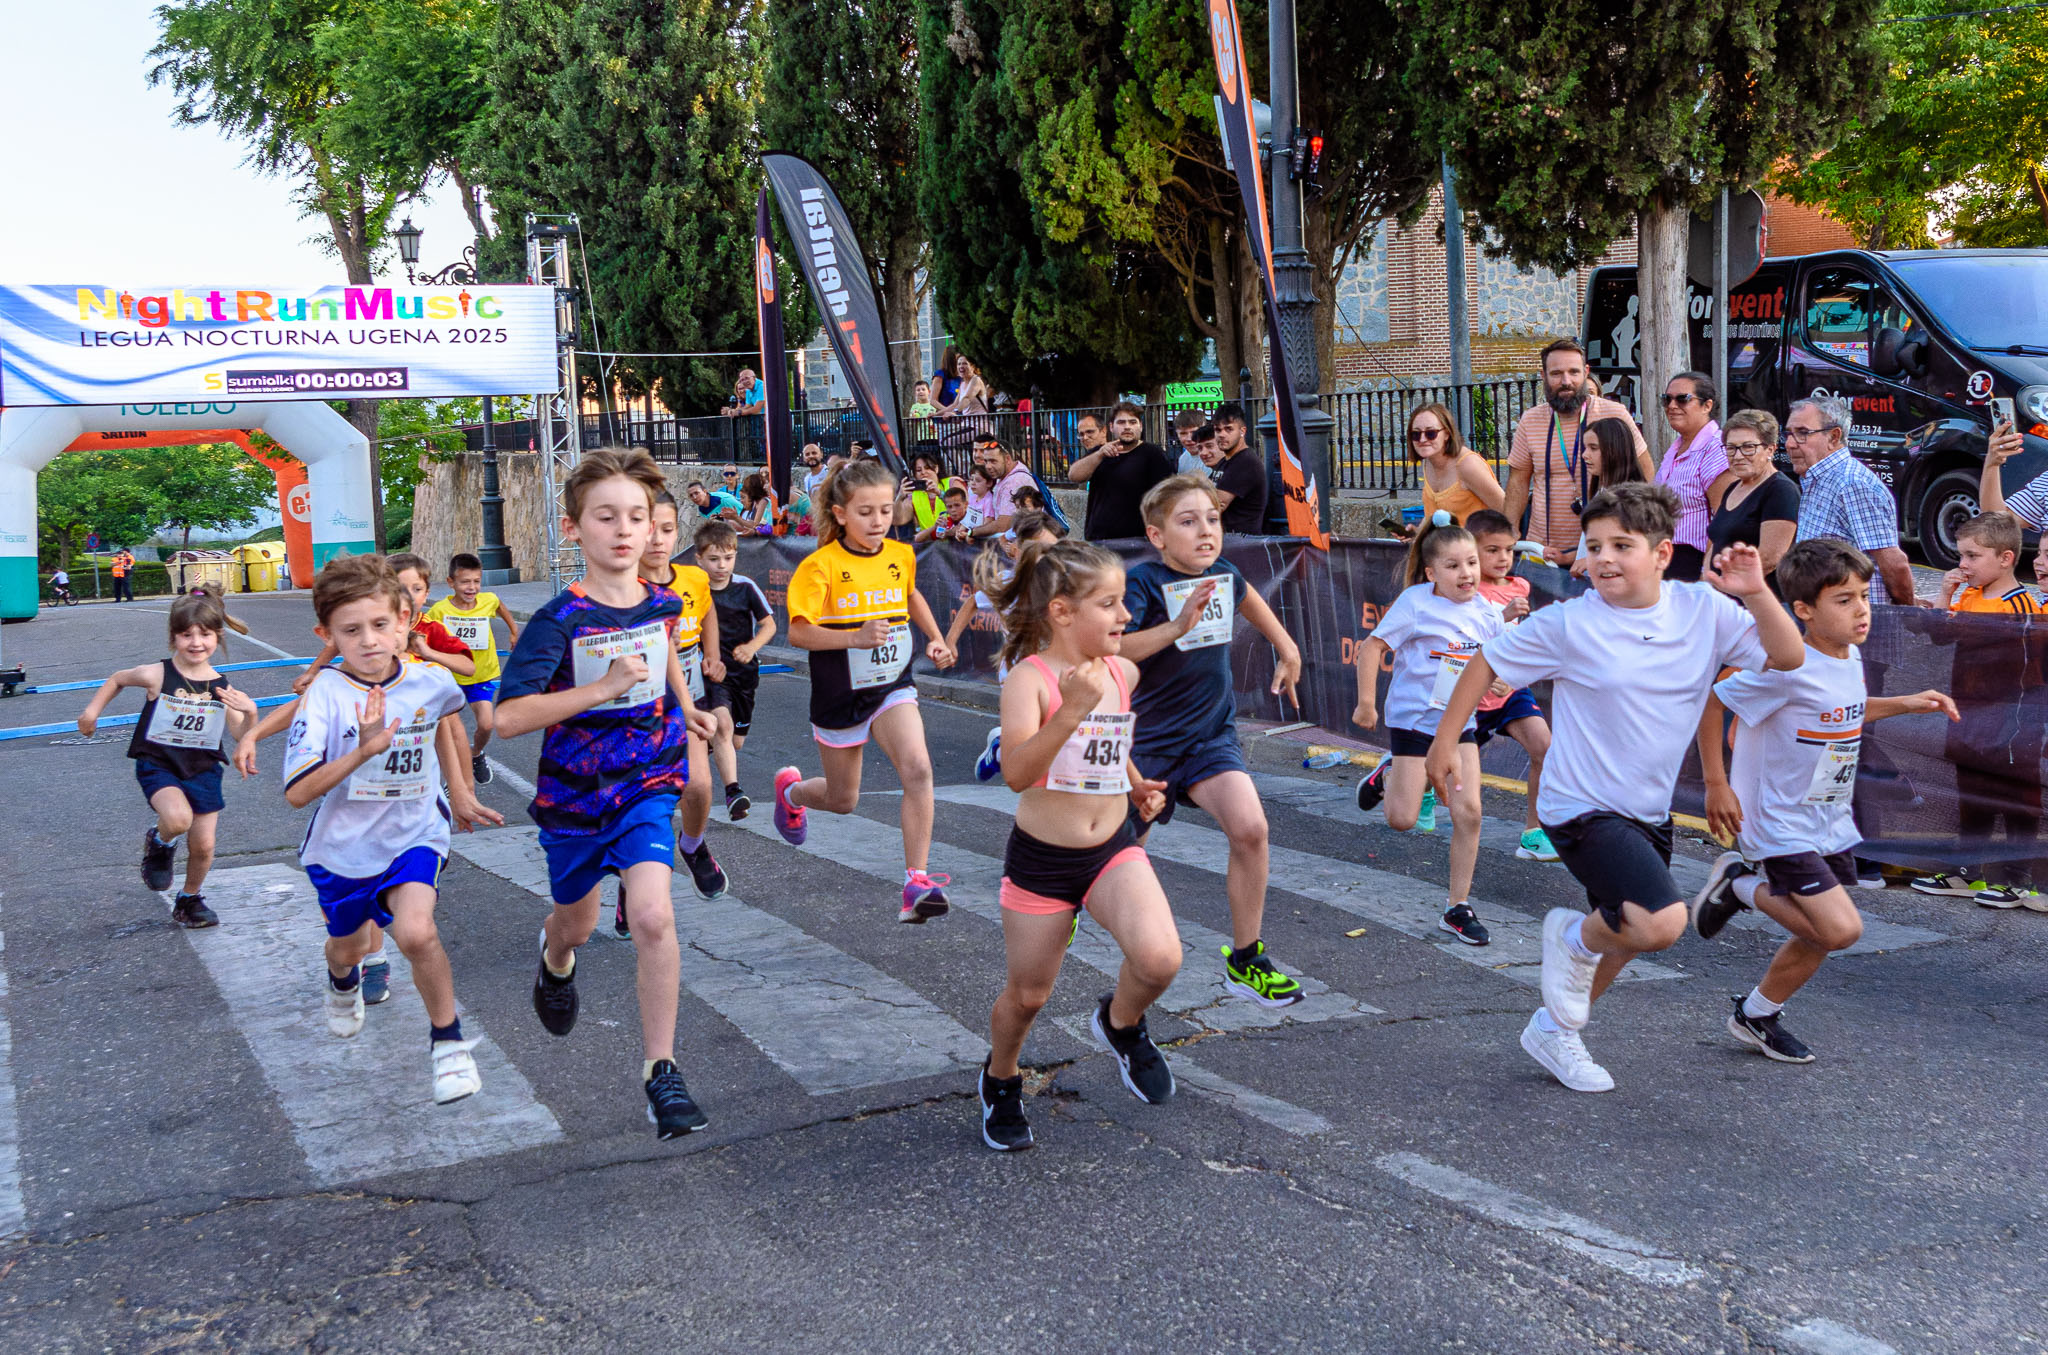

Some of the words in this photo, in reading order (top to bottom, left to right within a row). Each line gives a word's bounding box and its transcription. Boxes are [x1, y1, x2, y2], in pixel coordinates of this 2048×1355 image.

[1685, 286, 1784, 319] forvent
[81, 331, 173, 347] LEGUA
[184, 330, 340, 346] NOCTURNA
[349, 329, 441, 345] UGENA
[449, 328, 508, 344] 2025
[228, 374, 295, 386] sumialki
[295, 371, 404, 389] 00:00:03
[1862, 426, 1871, 434] 53
[1873, 426, 1882, 435] 74
[837, 592, 859, 609] e3
[863, 588, 903, 606] TEAM
[1200, 597, 1223, 622] 35
[456, 627, 477, 639] 429
[586, 635, 609, 647] LEGUA
[609, 629, 643, 642] NOCTURNA
[871, 644, 899, 666] 432
[173, 714, 206, 731] 428
[384, 748, 424, 775] 433
[1083, 739, 1121, 767] 434
